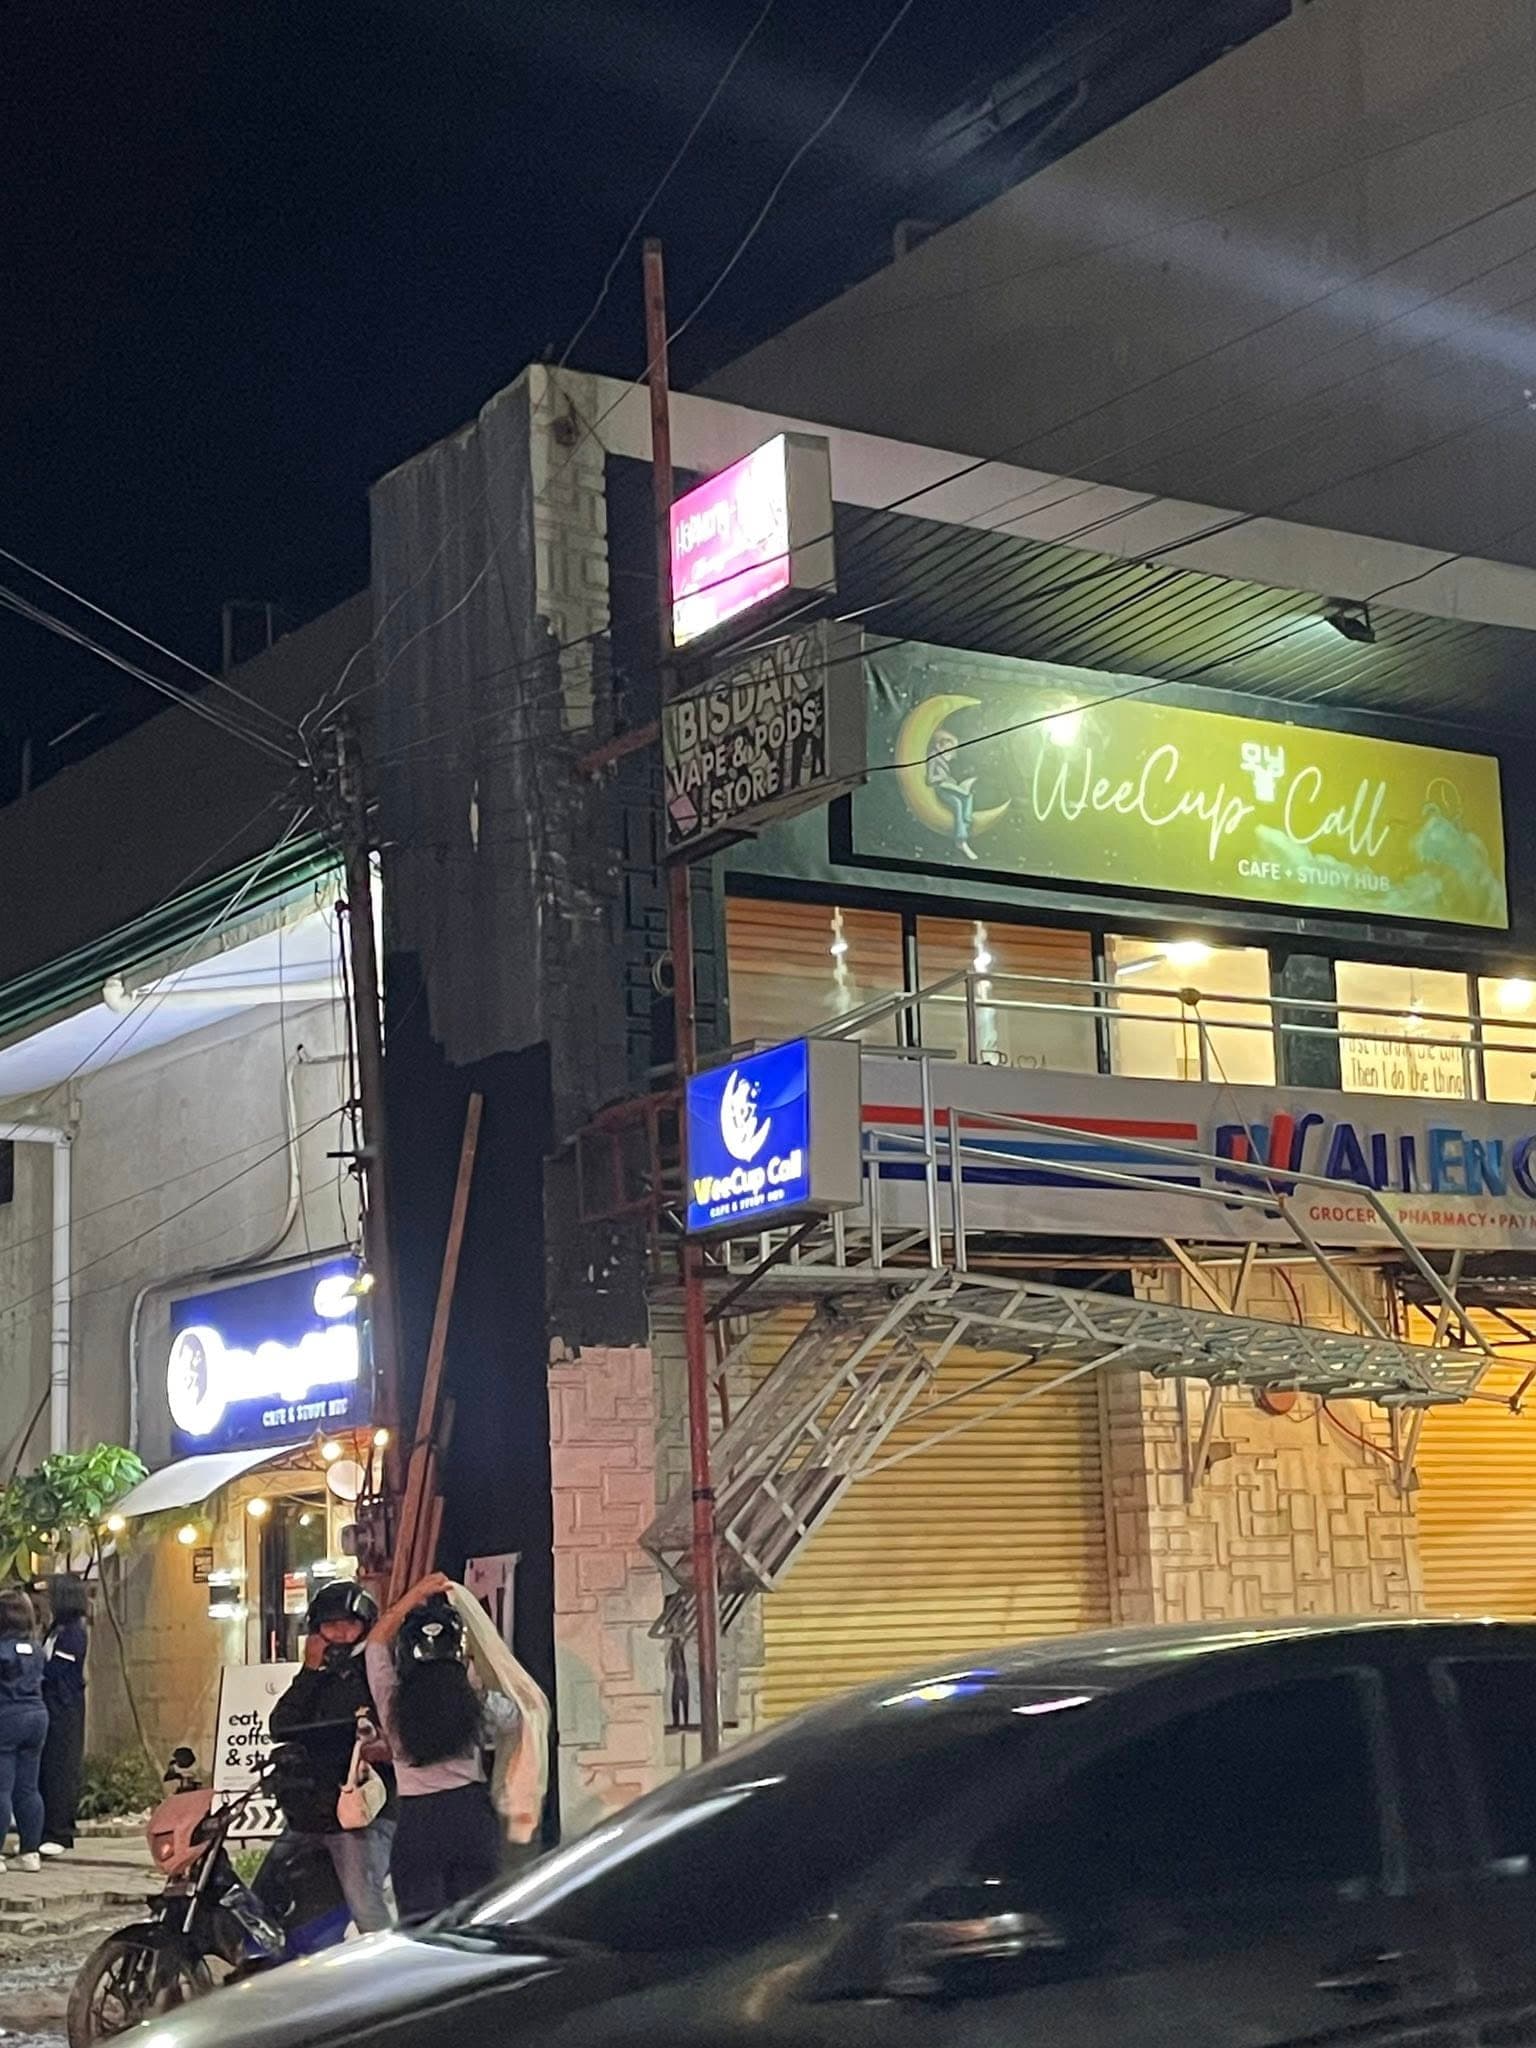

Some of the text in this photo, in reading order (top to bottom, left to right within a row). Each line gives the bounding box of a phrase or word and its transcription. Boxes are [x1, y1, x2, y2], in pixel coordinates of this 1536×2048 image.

[678, 635, 809, 751] BISDAK
[672, 699, 817, 796] VAPE & PODS
[711, 761, 779, 811] STORE
[1033, 742, 1390, 861] WeeCup Call
[1238, 859, 1391, 892] CAFE STUDY HUB
[1351, 1056, 1379, 1089] Then
[1391, 1061, 1405, 1090] do
[1410, 1065, 1429, 1093] the
[694, 1167, 765, 1205] WeeCup
[1310, 1206, 1378, 1223] GROCER
[1399, 1209, 1487, 1227] PHARMACY
[227, 1726, 271, 1746] coffe
[229, 1710, 263, 1728] eat,
[226, 1749, 241, 1766] &
